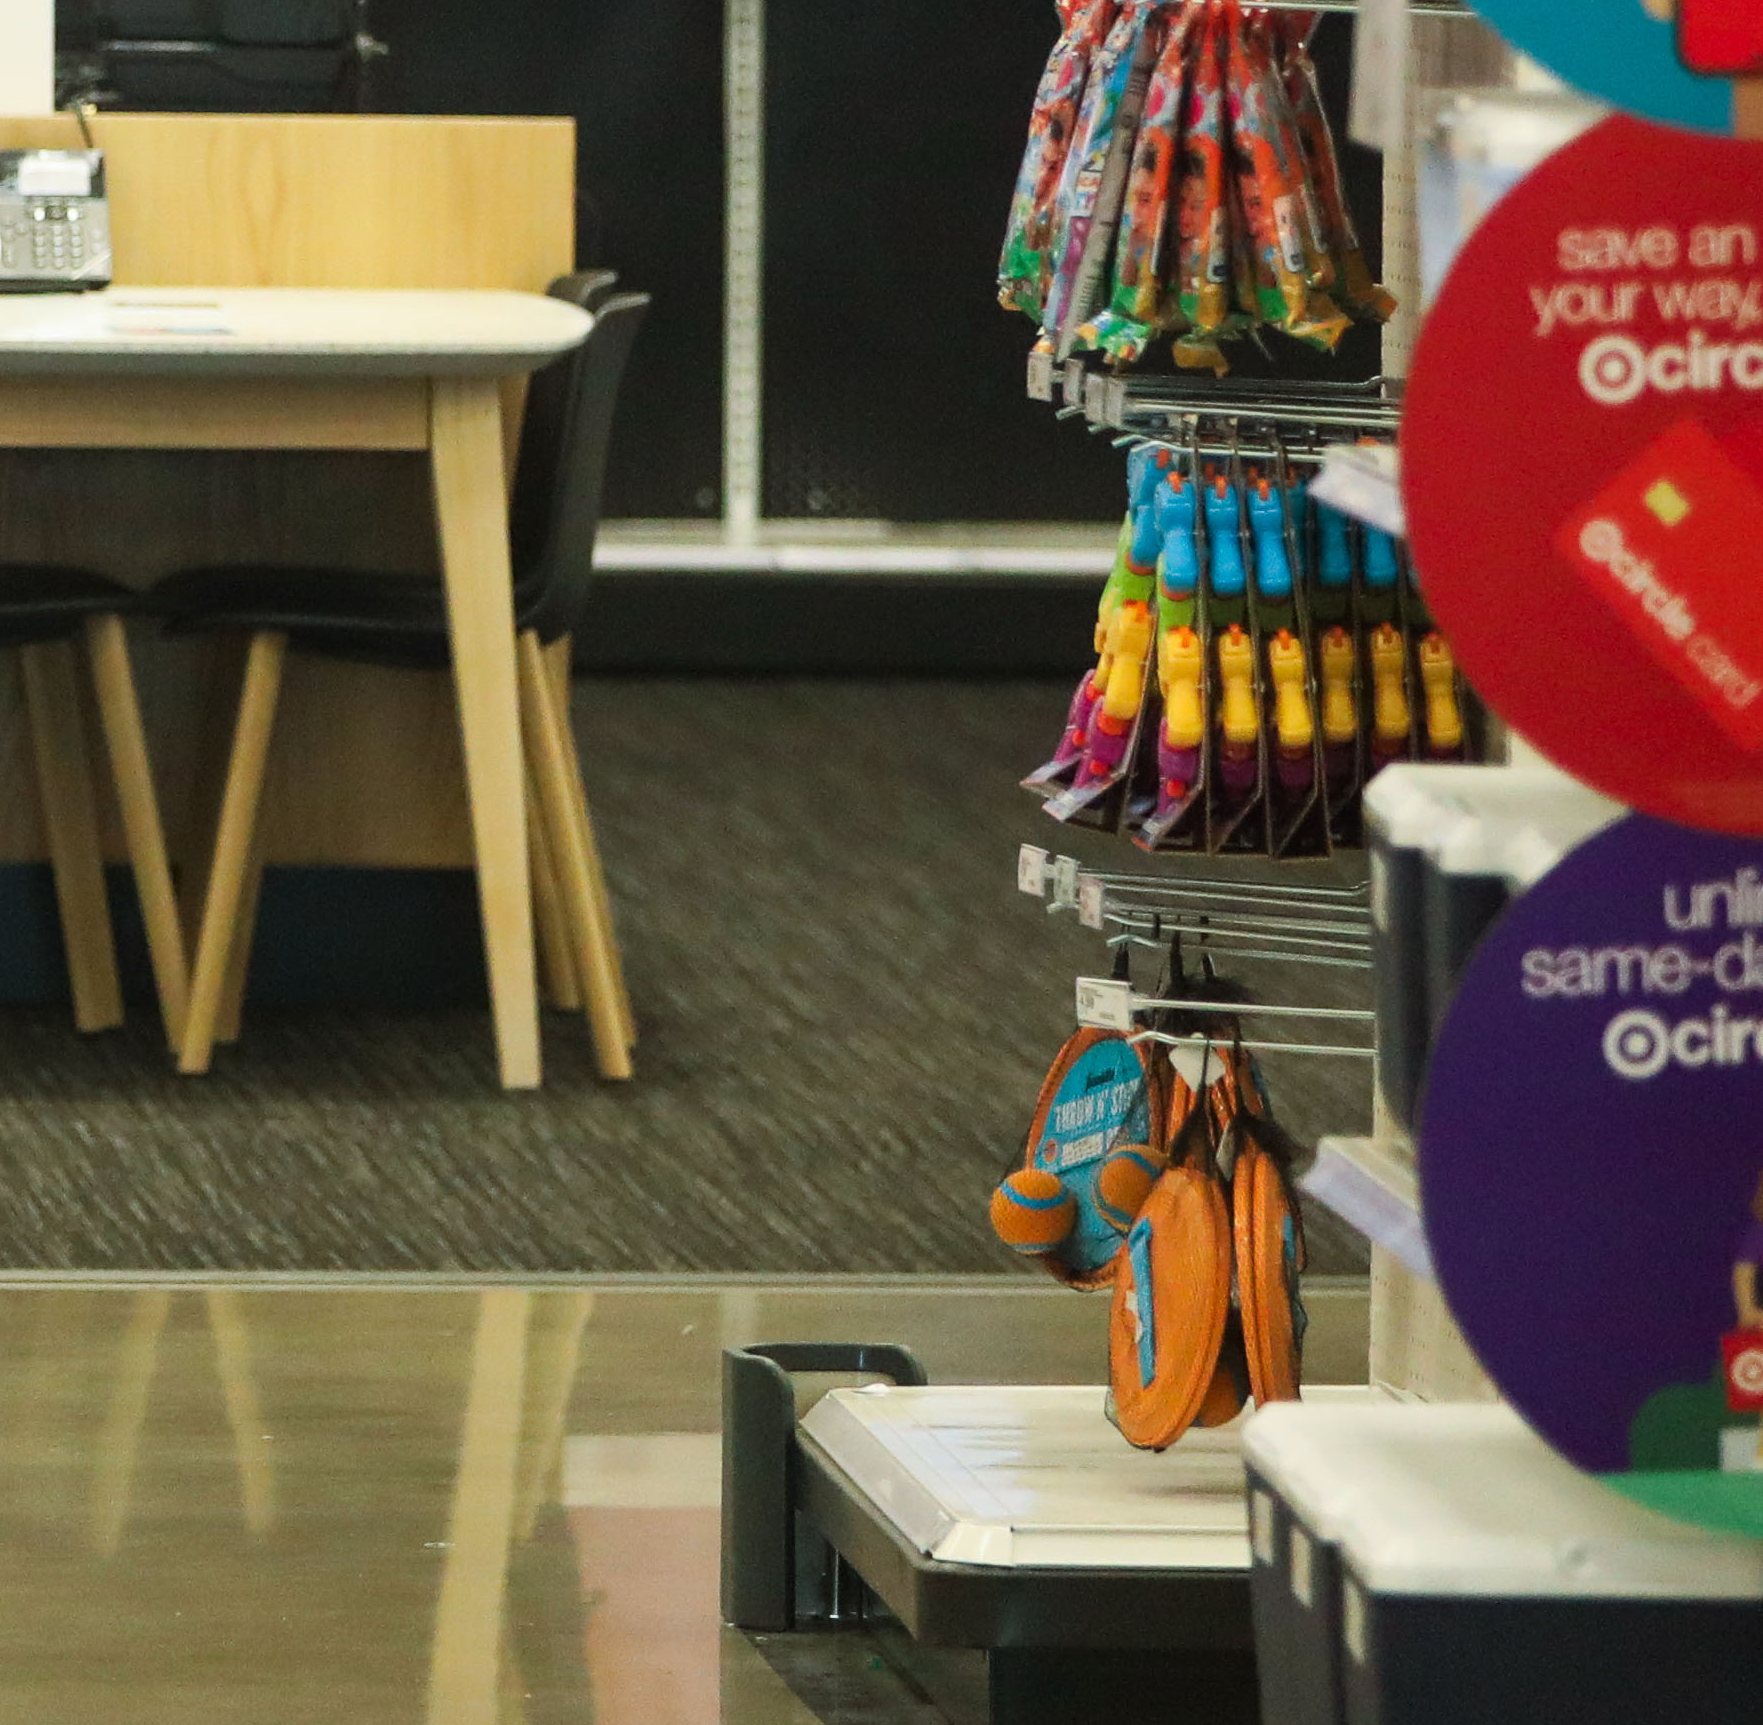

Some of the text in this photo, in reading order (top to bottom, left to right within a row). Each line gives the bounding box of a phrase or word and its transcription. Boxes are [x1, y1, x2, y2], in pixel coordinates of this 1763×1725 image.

[1556, 224, 1758, 271] save an
[1527, 280, 1644, 338] your
[1647, 326, 1763, 393] circ
[1662, 863, 1763, 931] unli
[1520, 930, 1763, 999] same-d
[1672, 1002, 1763, 1068] cir
